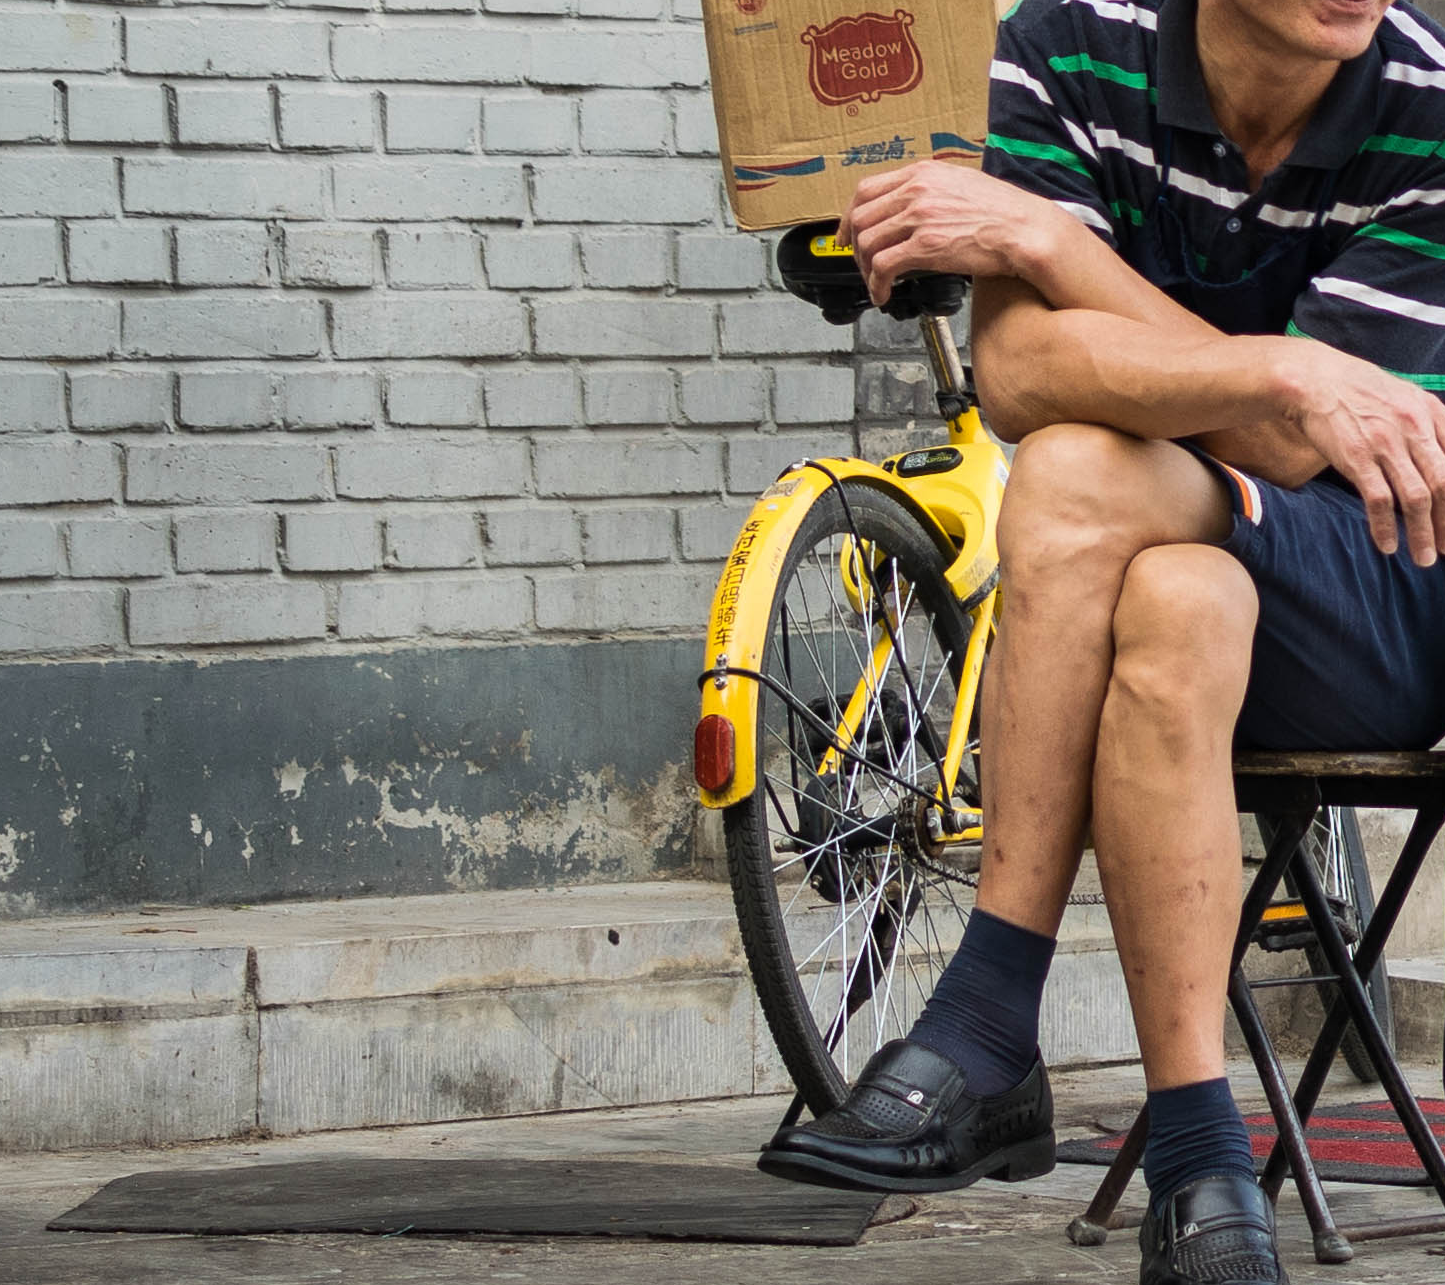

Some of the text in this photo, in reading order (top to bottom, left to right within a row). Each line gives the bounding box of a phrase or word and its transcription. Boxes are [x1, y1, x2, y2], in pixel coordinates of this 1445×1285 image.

[821, 40, 903, 65] Meadow
[841, 60, 889, 80] Gold
[713, 519, 764, 647] 支付宝扫码骑车
